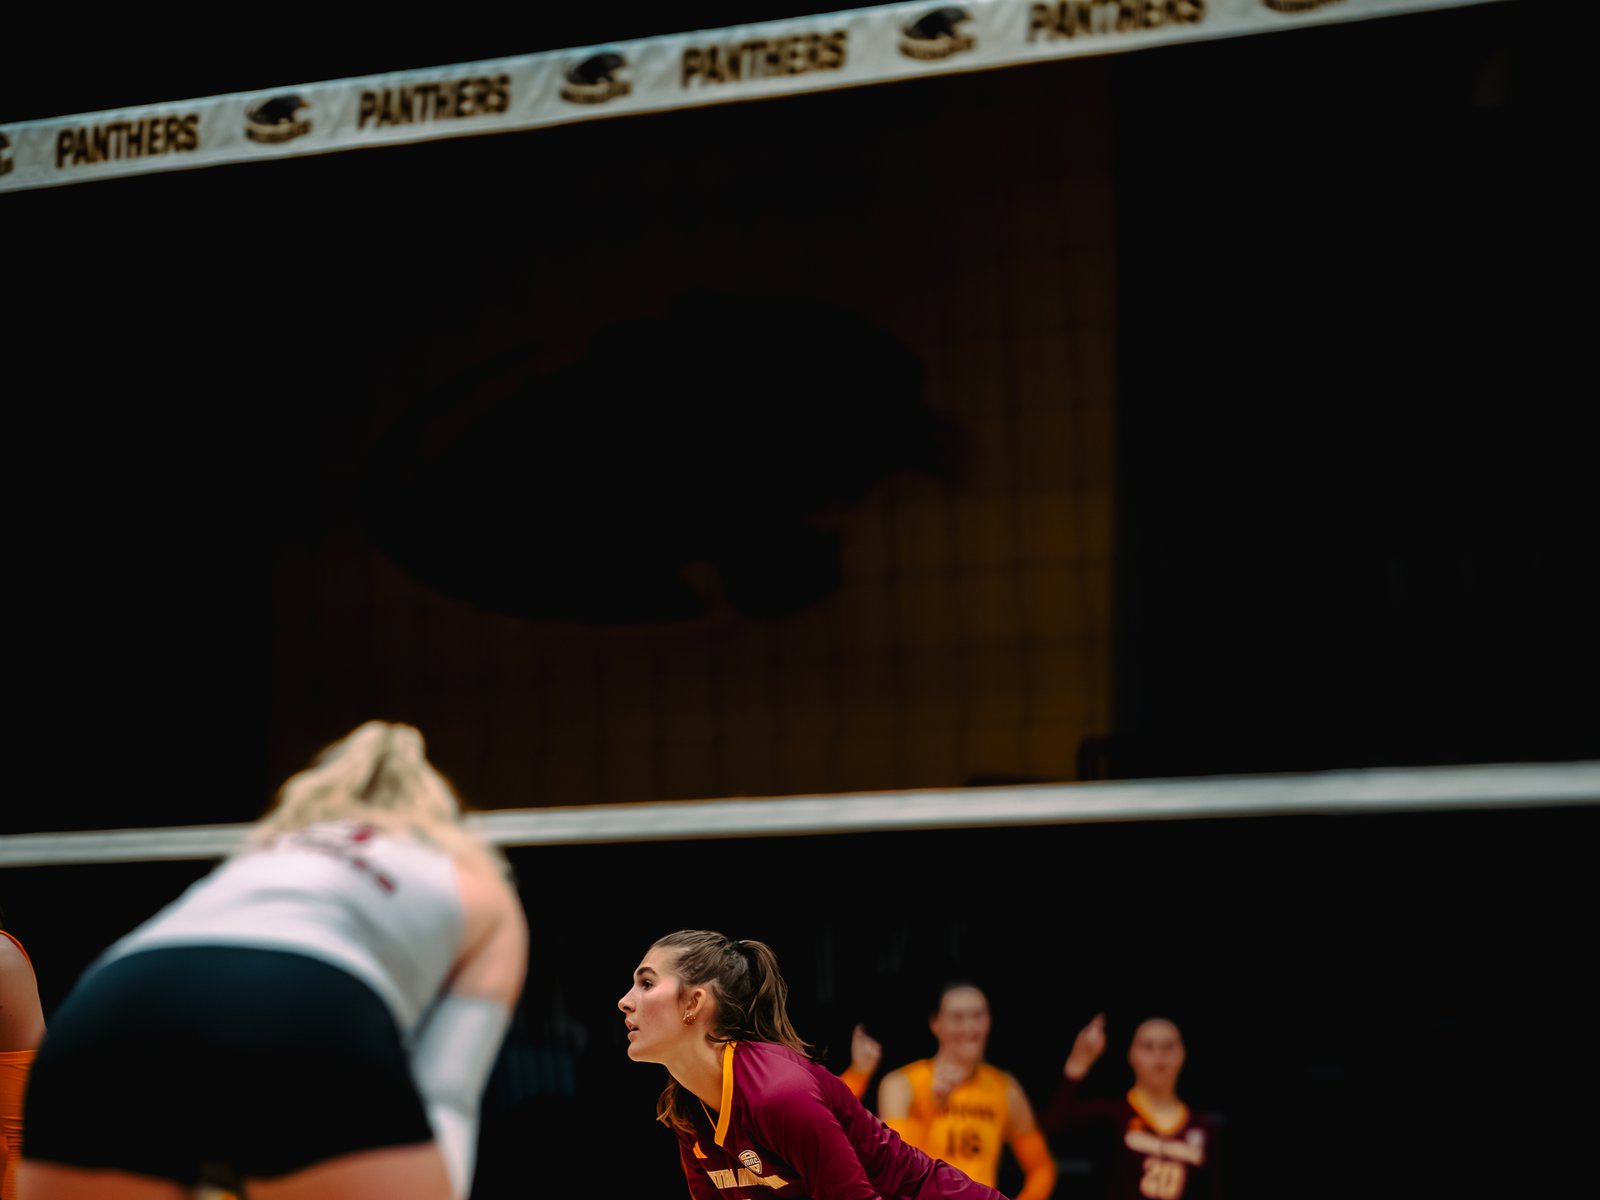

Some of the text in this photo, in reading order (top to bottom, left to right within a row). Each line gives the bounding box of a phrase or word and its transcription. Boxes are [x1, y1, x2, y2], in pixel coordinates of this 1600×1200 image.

[56, 113, 199, 169] PANTHERS
[358, 74, 511, 129] PANTHERS
[681, 30, 848, 89] PANTHERS
[1026, 0, 1208, 43] PANTHERS
[1139, 1157, 1187, 1200] 20
